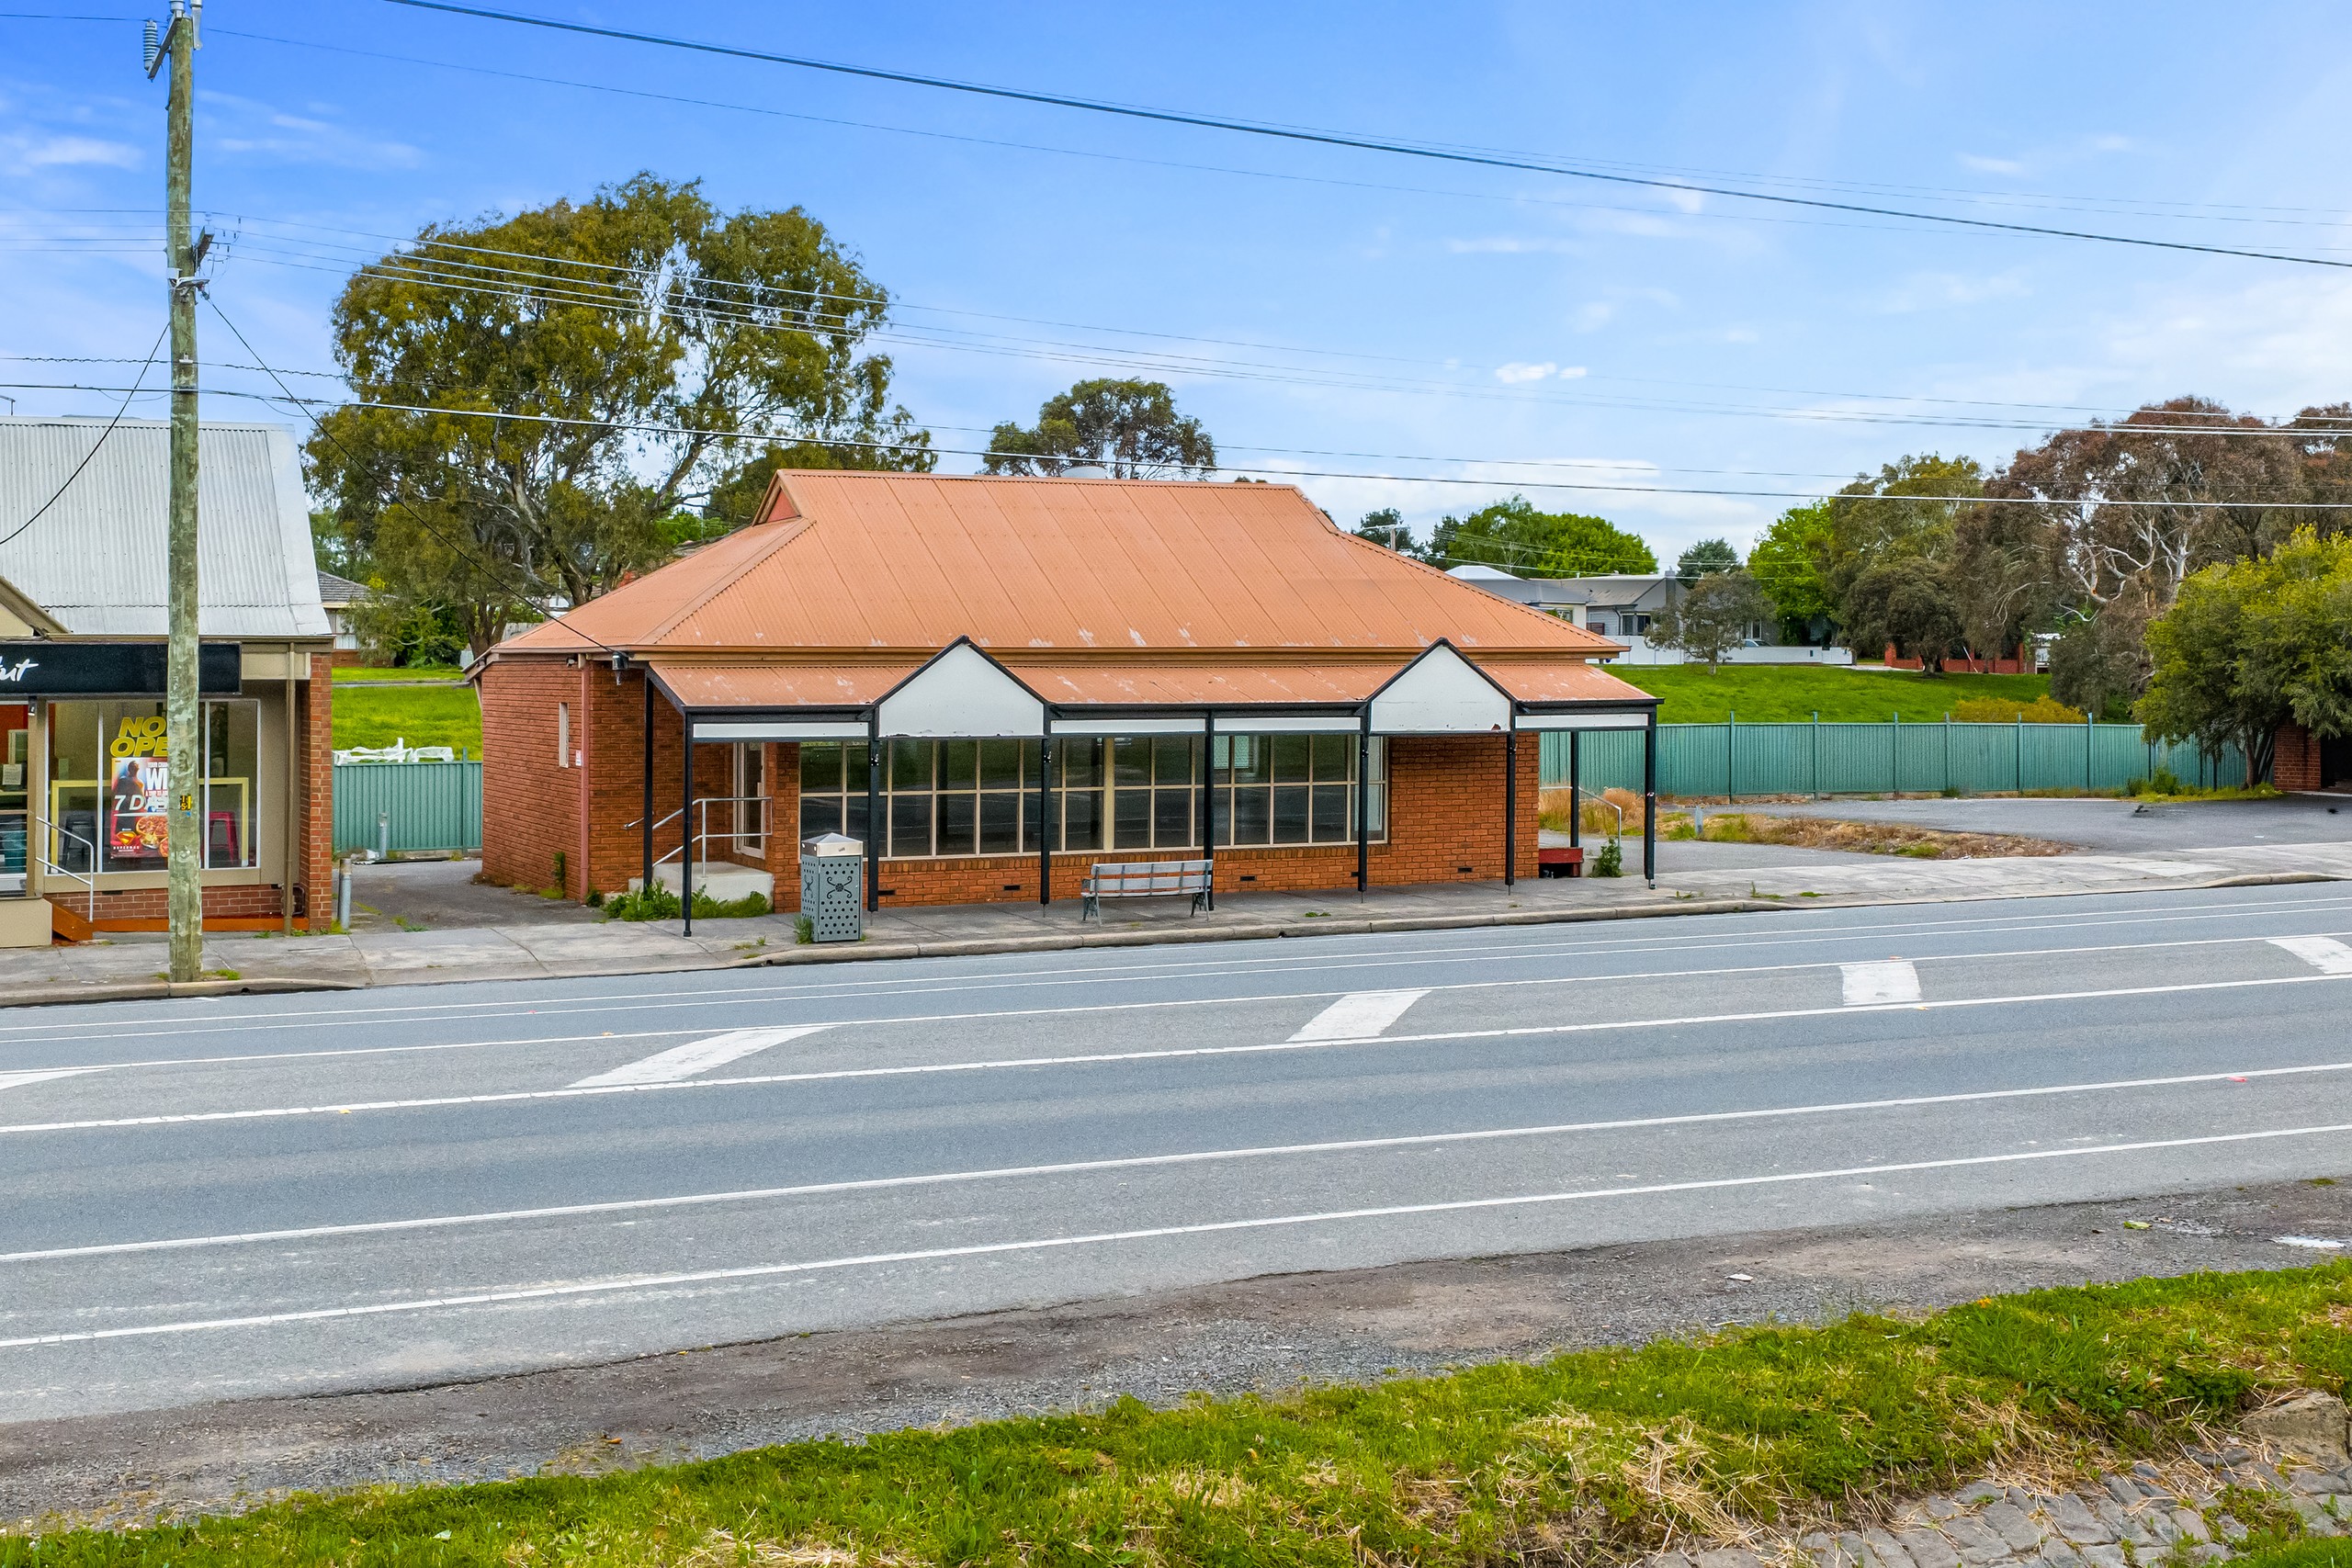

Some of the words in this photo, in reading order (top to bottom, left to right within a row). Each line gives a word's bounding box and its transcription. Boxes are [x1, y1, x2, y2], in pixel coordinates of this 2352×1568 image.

[0, 656, 40, 682] ut
[119, 716, 167, 738] NO
[110, 737, 168, 758] OPE
[146, 767, 168, 791] WI
[114, 795, 127, 811] 7
